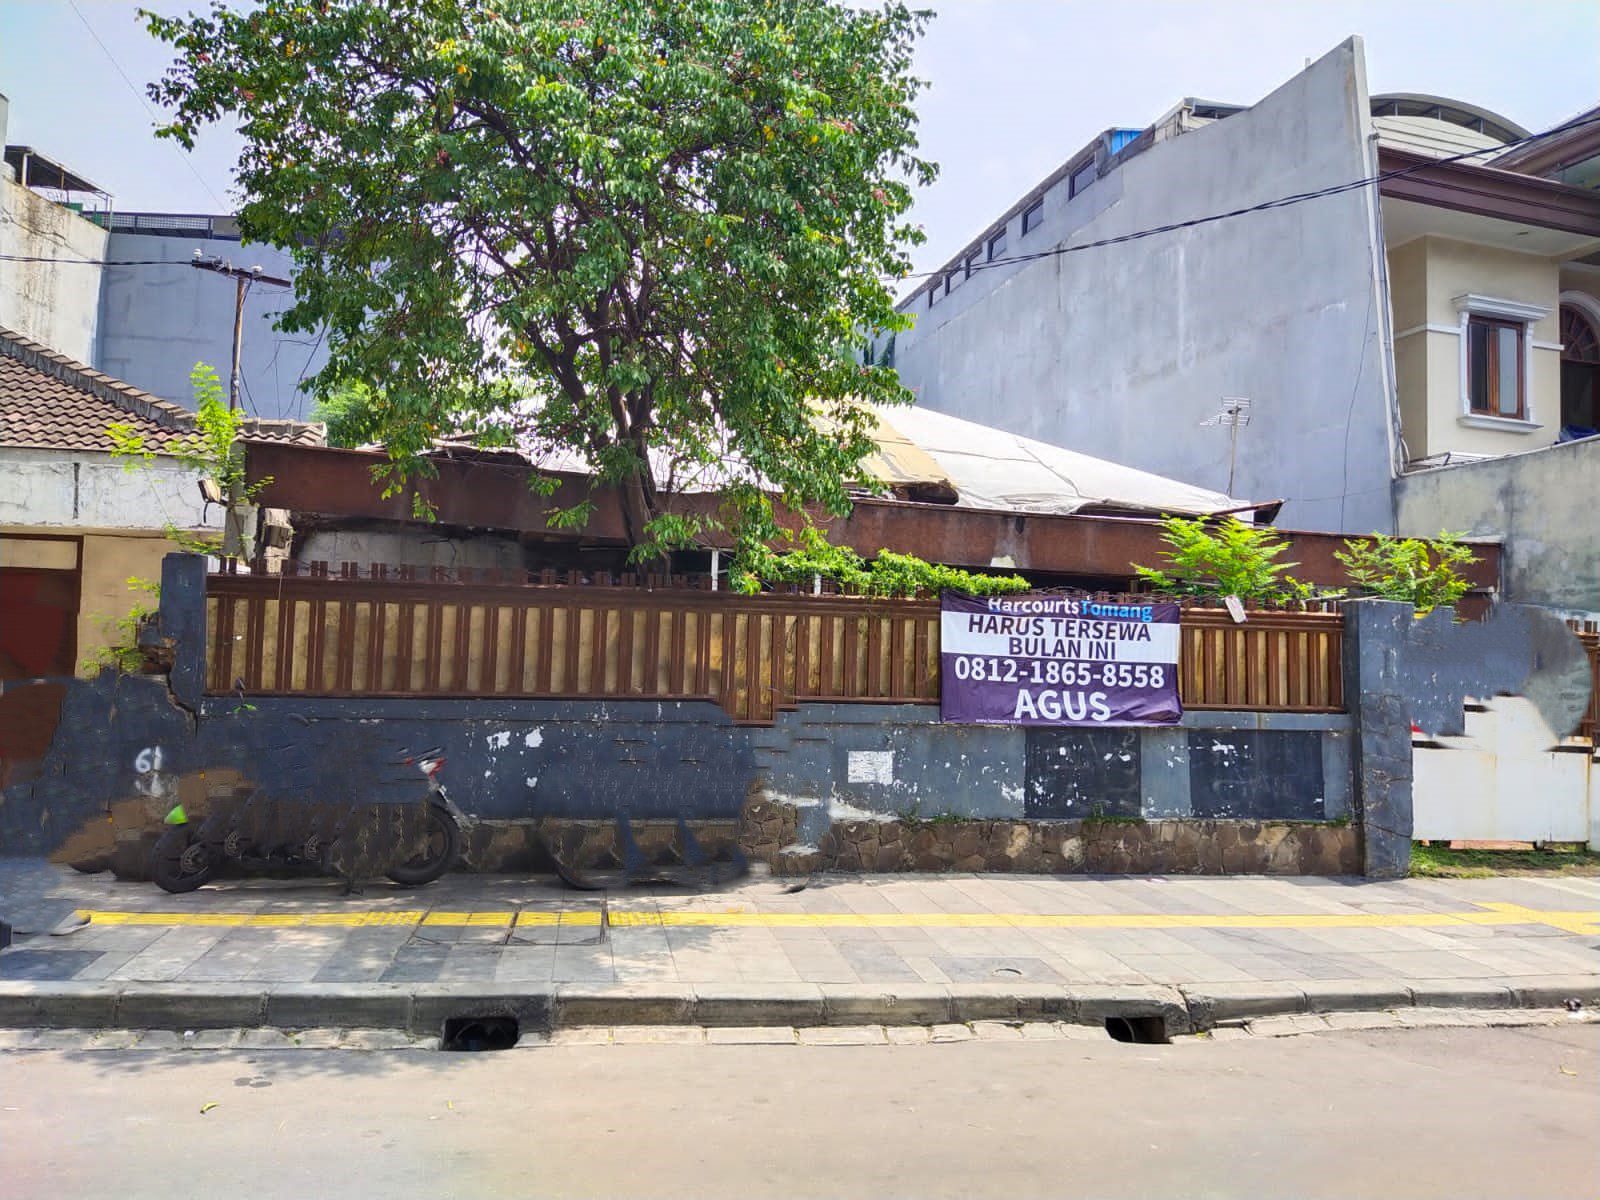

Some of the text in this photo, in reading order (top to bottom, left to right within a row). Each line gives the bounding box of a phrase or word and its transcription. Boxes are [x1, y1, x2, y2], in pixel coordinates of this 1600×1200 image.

[968, 614, 1152, 642] HARUS TERSEWA
[1008, 637, 1117, 660] BULAN INI
[954, 656, 1165, 689] 0812-1865-8558
[1013, 688, 1111, 722] AGUS
